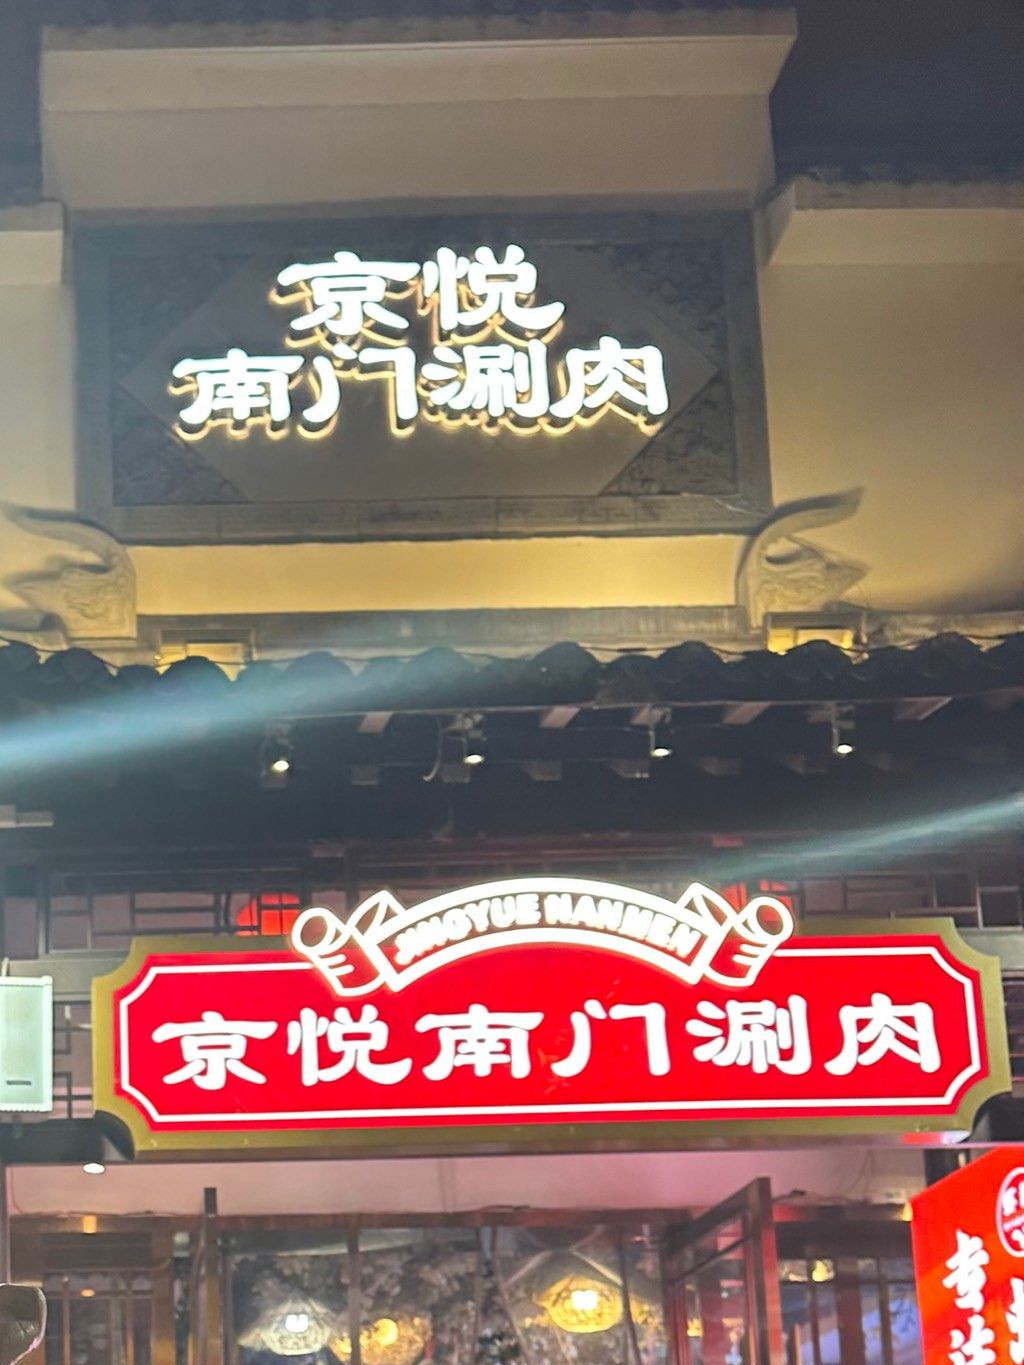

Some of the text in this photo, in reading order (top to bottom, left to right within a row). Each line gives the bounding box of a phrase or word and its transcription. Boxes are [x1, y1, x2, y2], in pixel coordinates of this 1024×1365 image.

[275, 244, 565, 337] 京悦
[171, 335, 670, 425] 南门涮肉
[394, 893, 704, 963] JINGYUE NANMEN
[150, 991, 943, 1093] 京悦南门涮肉
